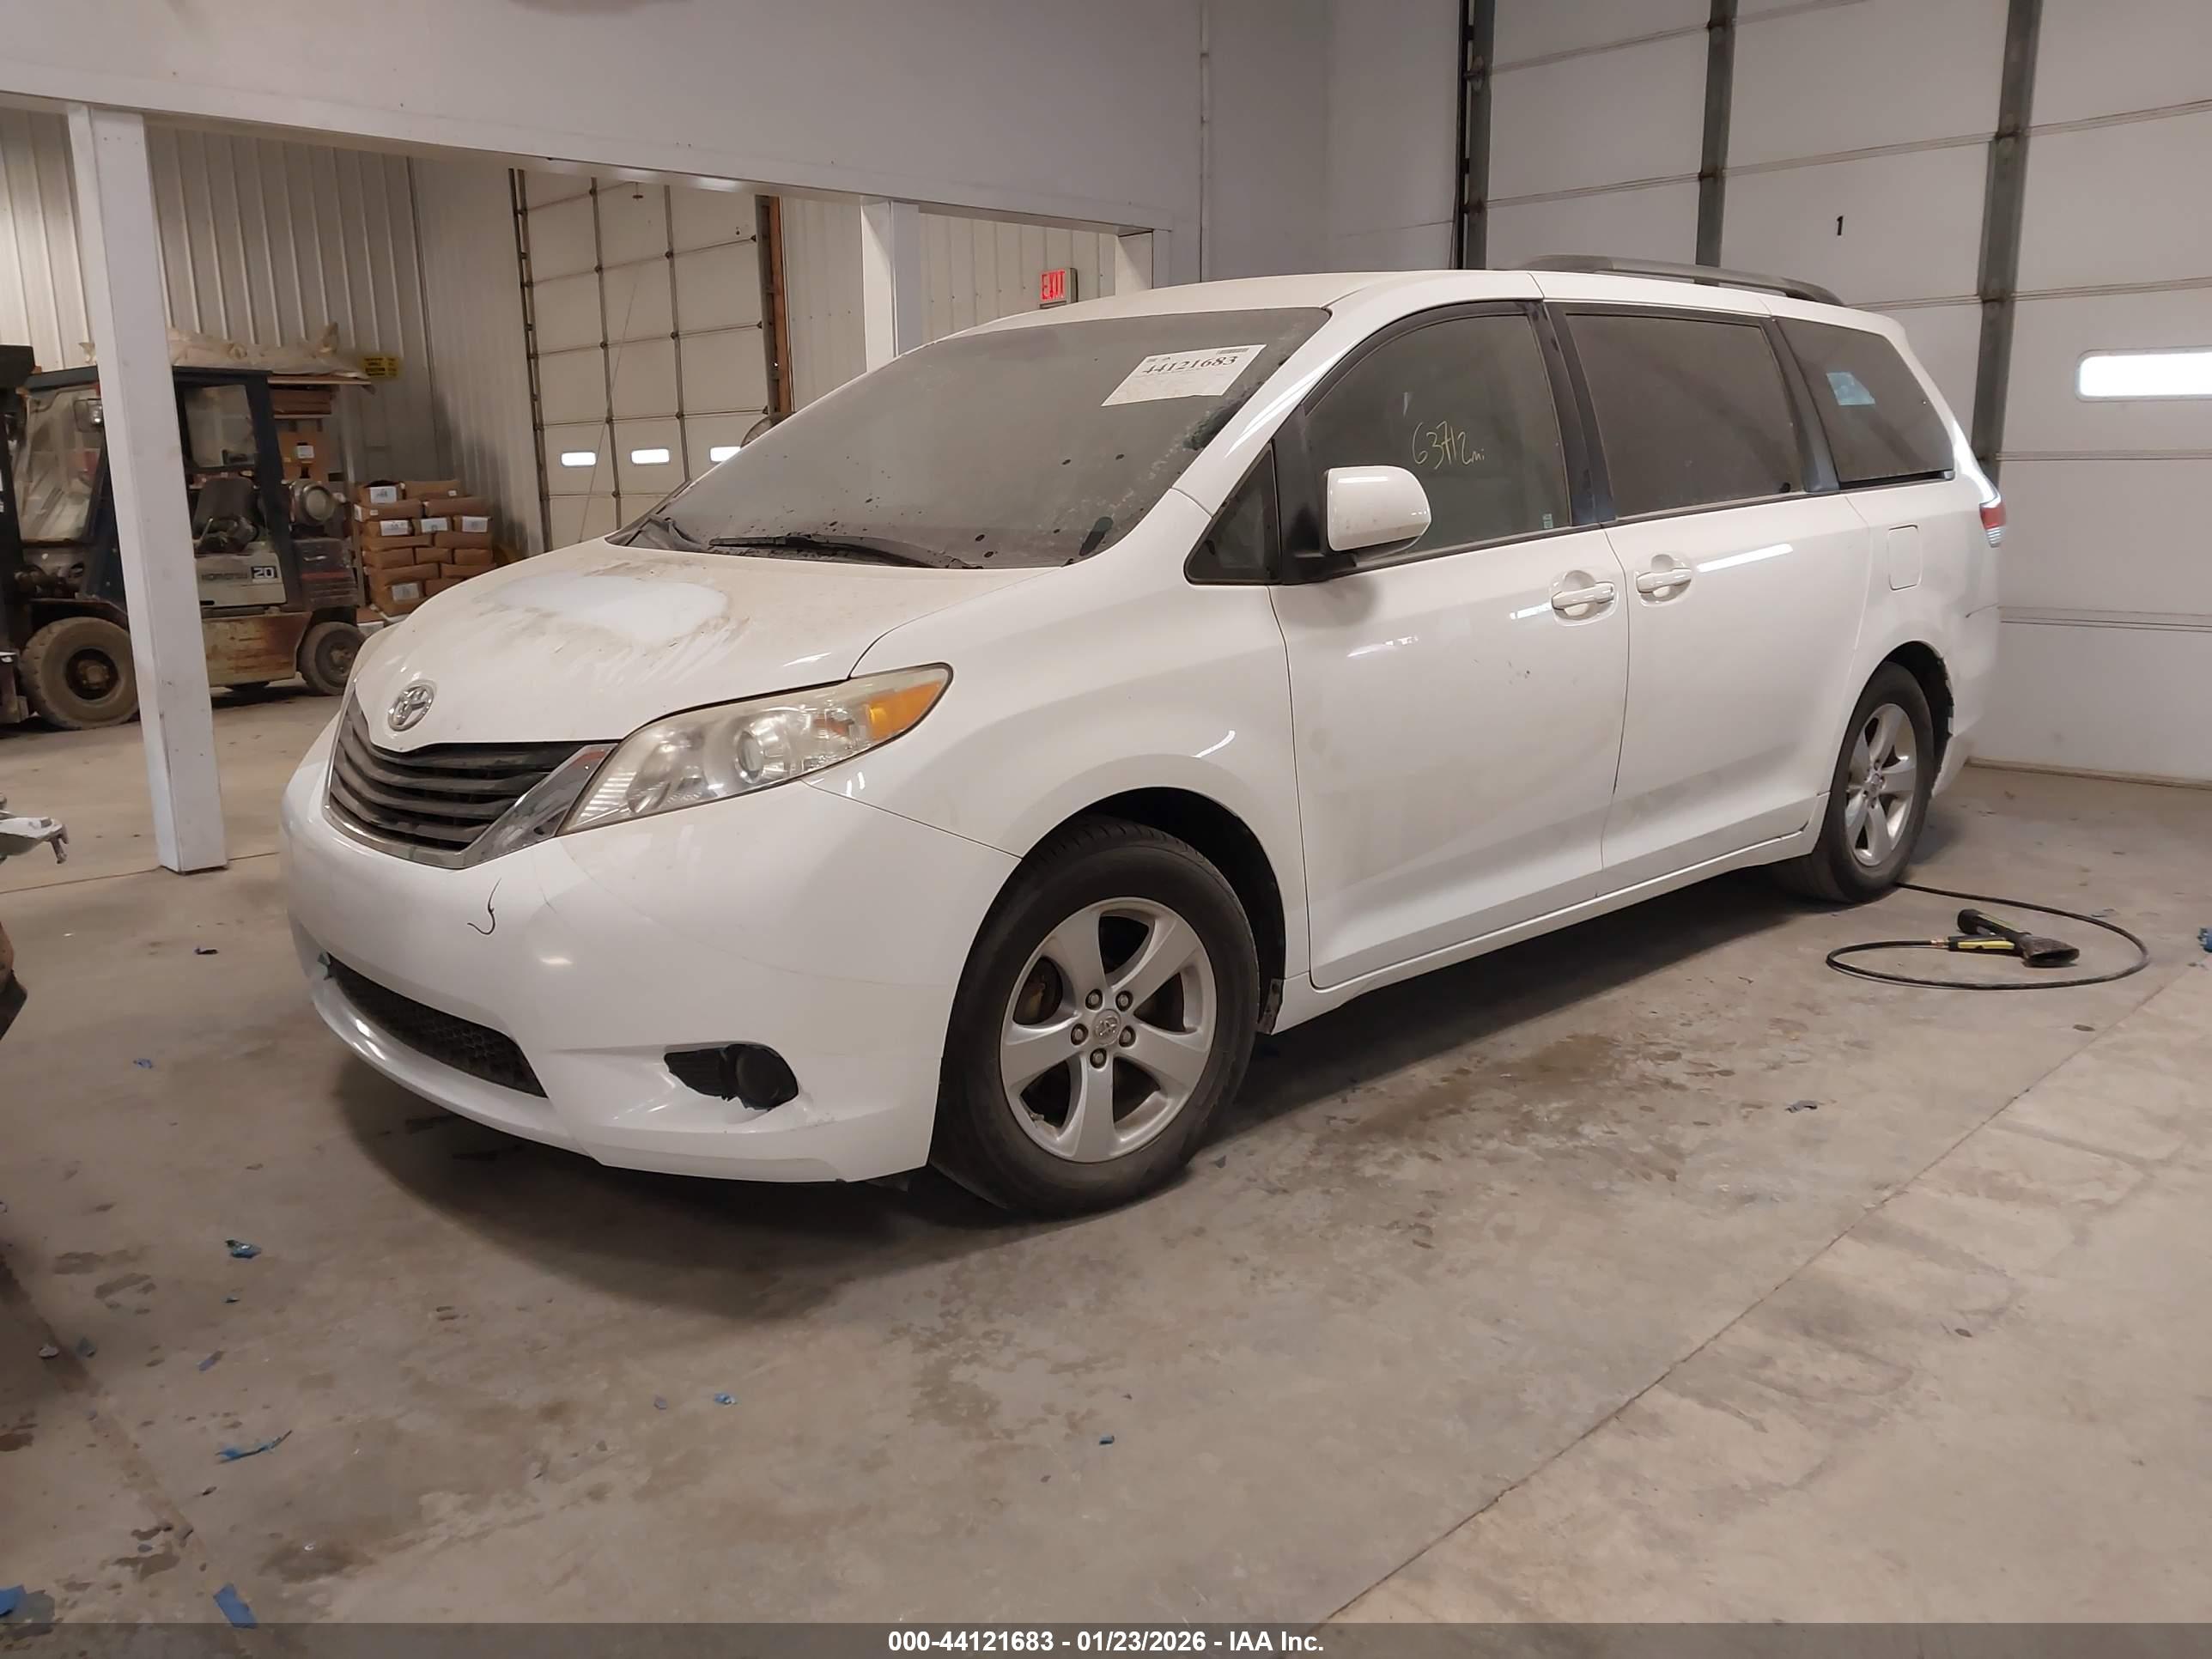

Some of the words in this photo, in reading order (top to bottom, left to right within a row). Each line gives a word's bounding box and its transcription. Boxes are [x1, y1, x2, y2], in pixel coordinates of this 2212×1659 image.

[1836, 215, 1844, 236] 1
[1041, 270, 1066, 301] EXIT
[1142, 356, 1238, 374] 44121683
[252, 566, 275, 579] 20
